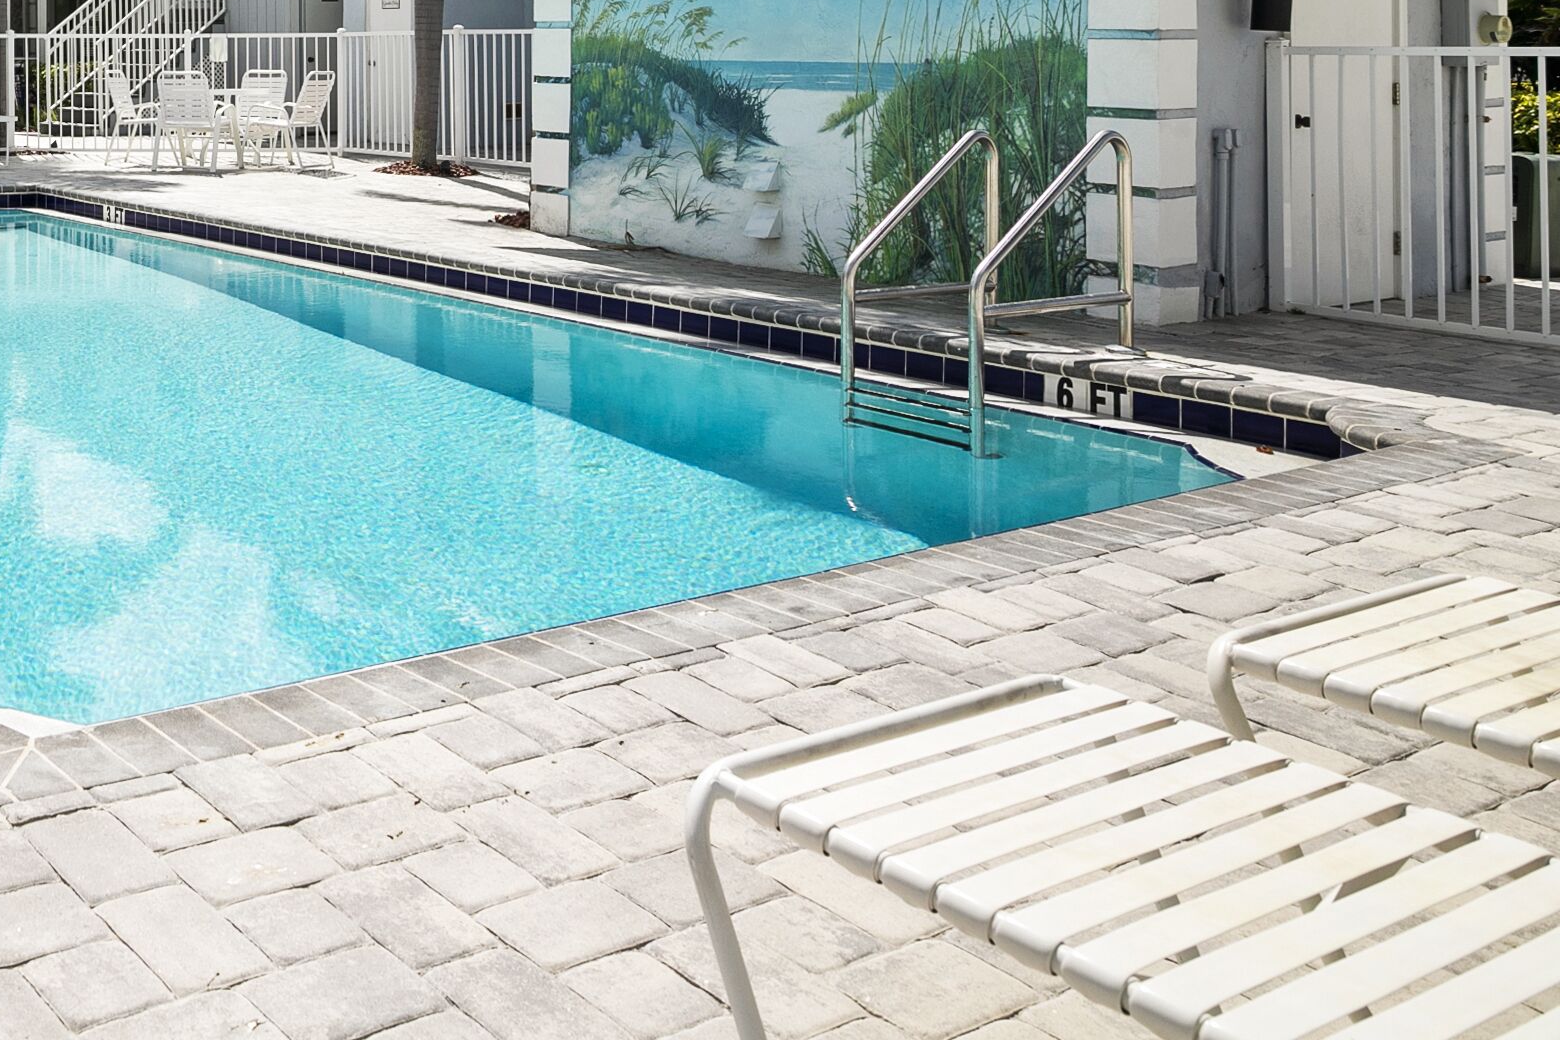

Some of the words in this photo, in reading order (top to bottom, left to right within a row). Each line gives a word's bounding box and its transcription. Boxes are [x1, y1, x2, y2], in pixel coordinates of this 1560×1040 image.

[106, 206, 111, 222] 3
[114, 207, 124, 225] FT
[1057, 377, 1074, 408] 6
[1090, 381, 1128, 418] FT
